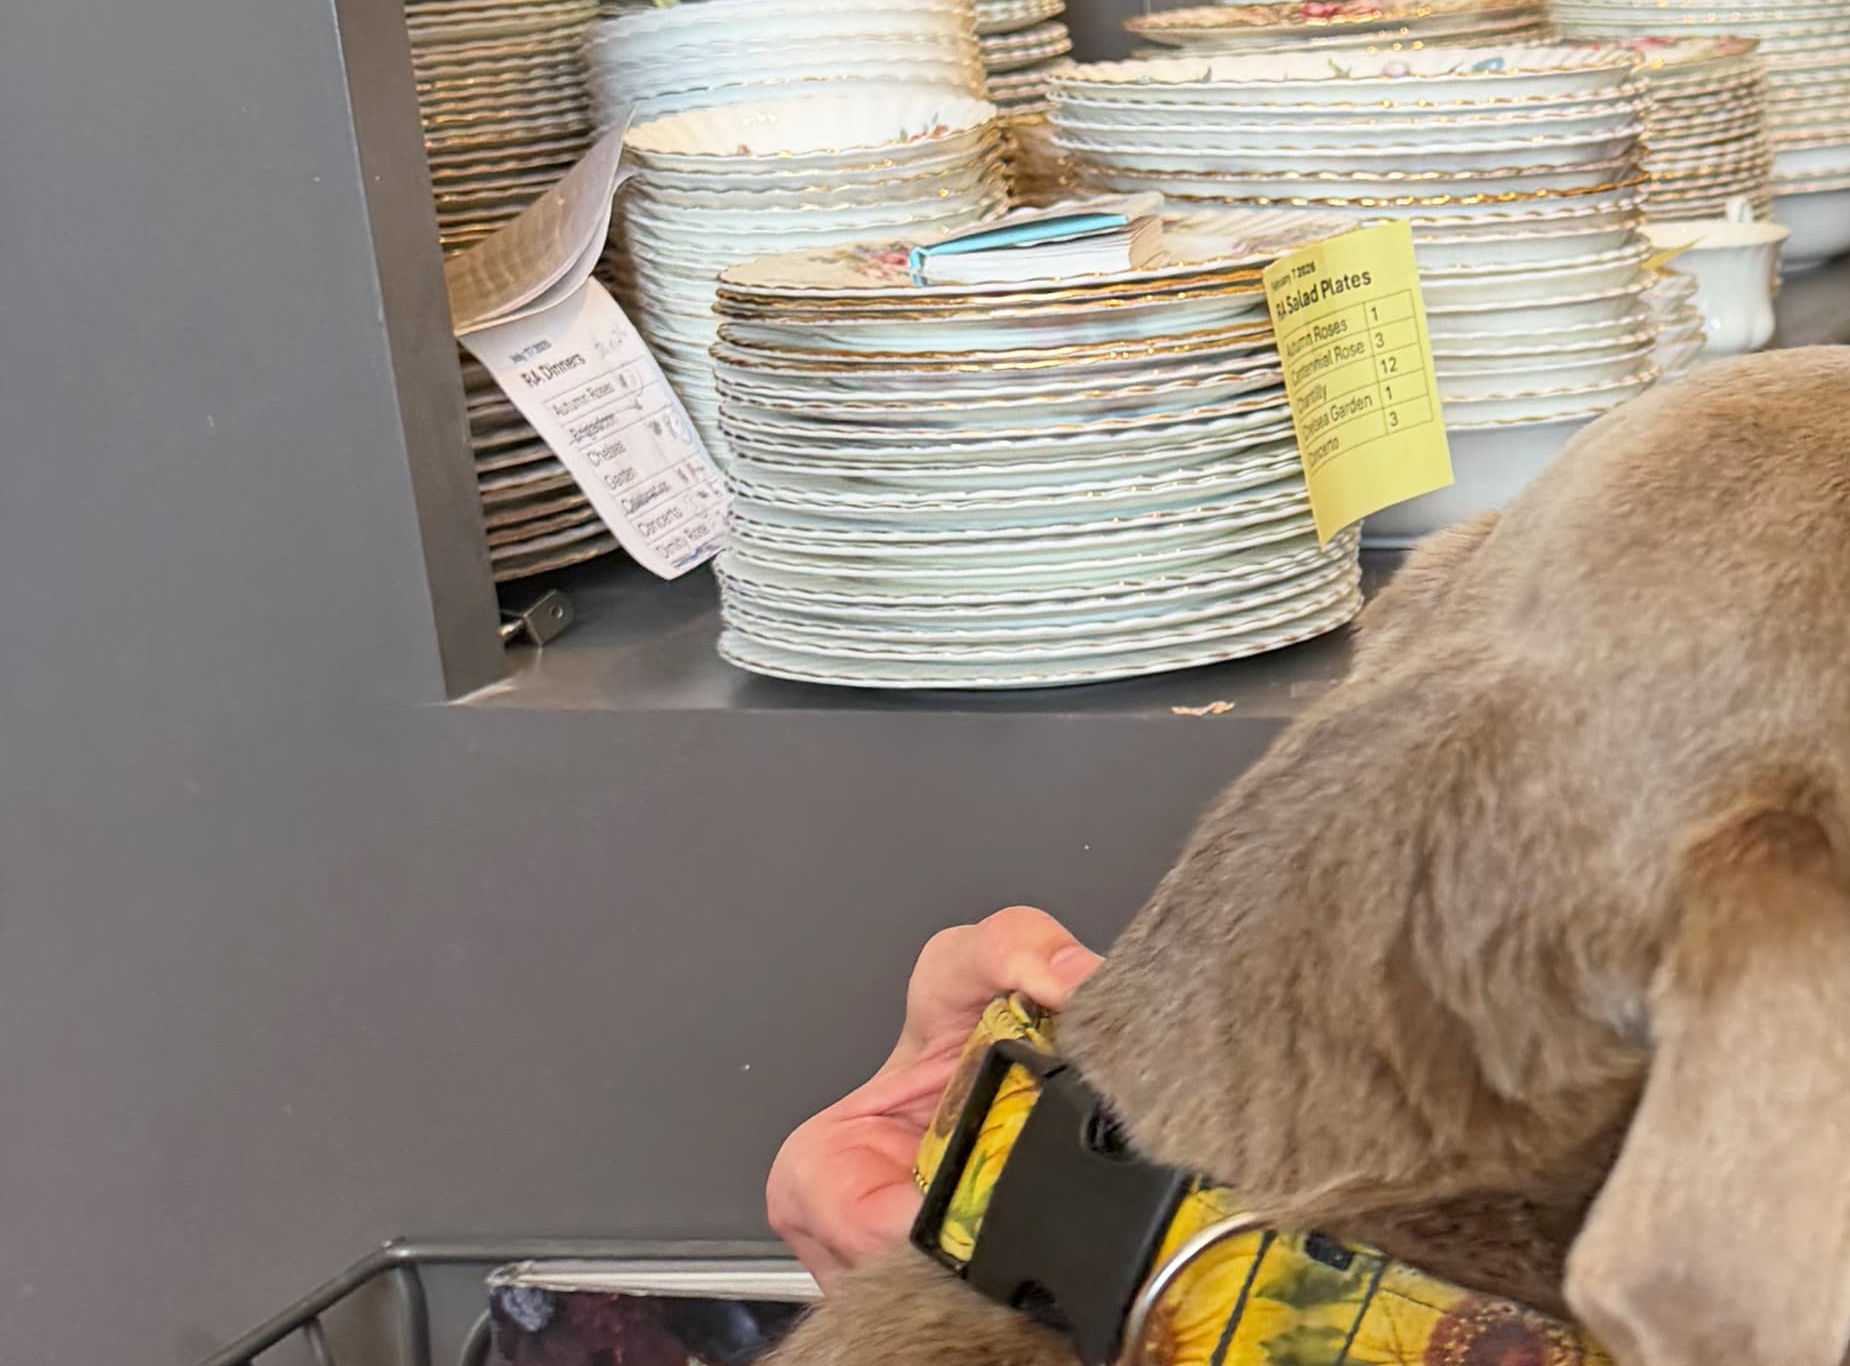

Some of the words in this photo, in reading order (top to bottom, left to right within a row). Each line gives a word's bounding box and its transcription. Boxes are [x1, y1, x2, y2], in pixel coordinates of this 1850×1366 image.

[1286, 283, 1319, 315] Salad
[1320, 270, 1373, 300] Plates
[1313, 318, 1349, 343] Roses
[1370, 306, 1379, 322] 1
[520, 370, 542, 388] RA
[538, 352, 587, 381] Dinners
[1290, 349, 1334, 385] Centennial
[1334, 340, 1366, 363] Rose
[1375, 332, 1385, 349] 3
[1380, 356, 1398, 375] 12
[552, 393, 589, 417] Autumn
[1330, 394, 1373, 422] Garden
[1384, 386, 1393, 401] 1
[1389, 411, 1399, 427] 3
[637, 506, 684, 537] Concerto
